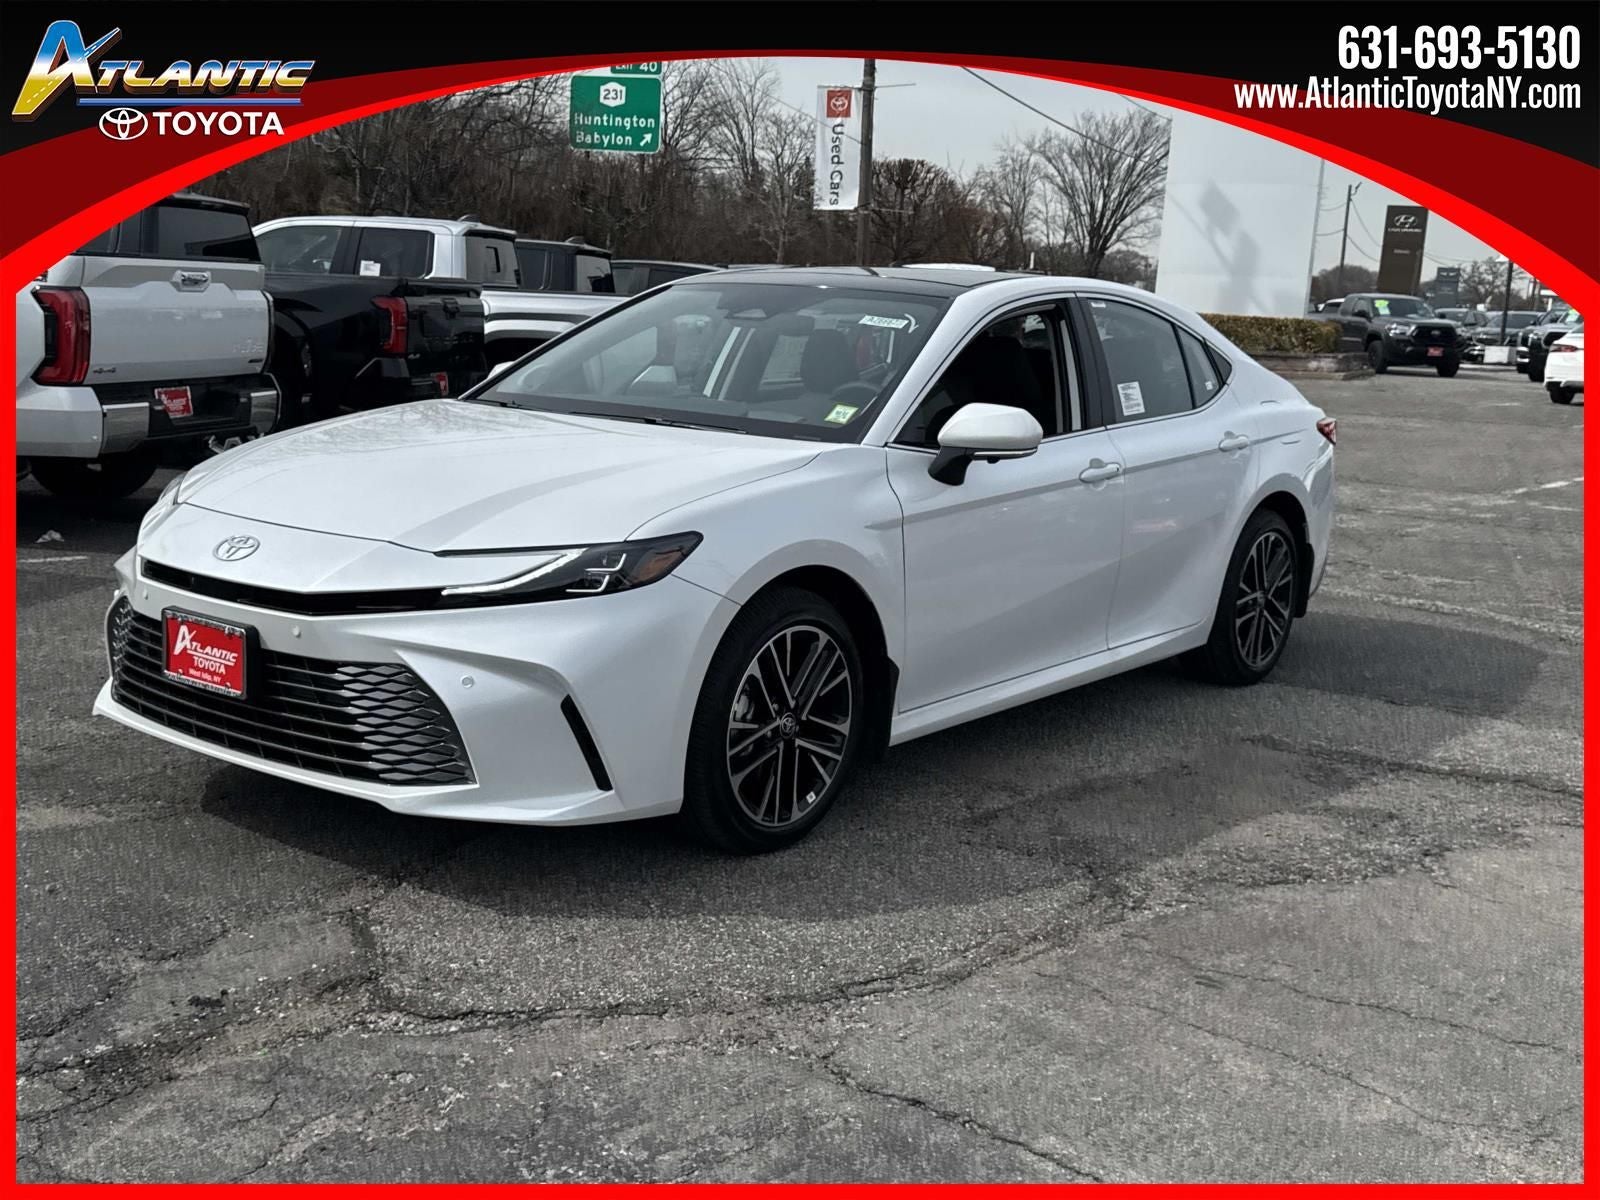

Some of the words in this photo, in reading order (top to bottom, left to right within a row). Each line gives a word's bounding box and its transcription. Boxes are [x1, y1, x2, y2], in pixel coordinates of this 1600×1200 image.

[639, 61, 658, 73] 40
[603, 88, 623, 100] 231
[574, 112, 655, 130] Huntington
[576, 131, 632, 147] Babylon
[831, 123, 844, 165] Used
[829, 170, 843, 206] Cars
[173, 624, 238, 662] ATLANTIC
[192, 656, 226, 675] TOYOTA
